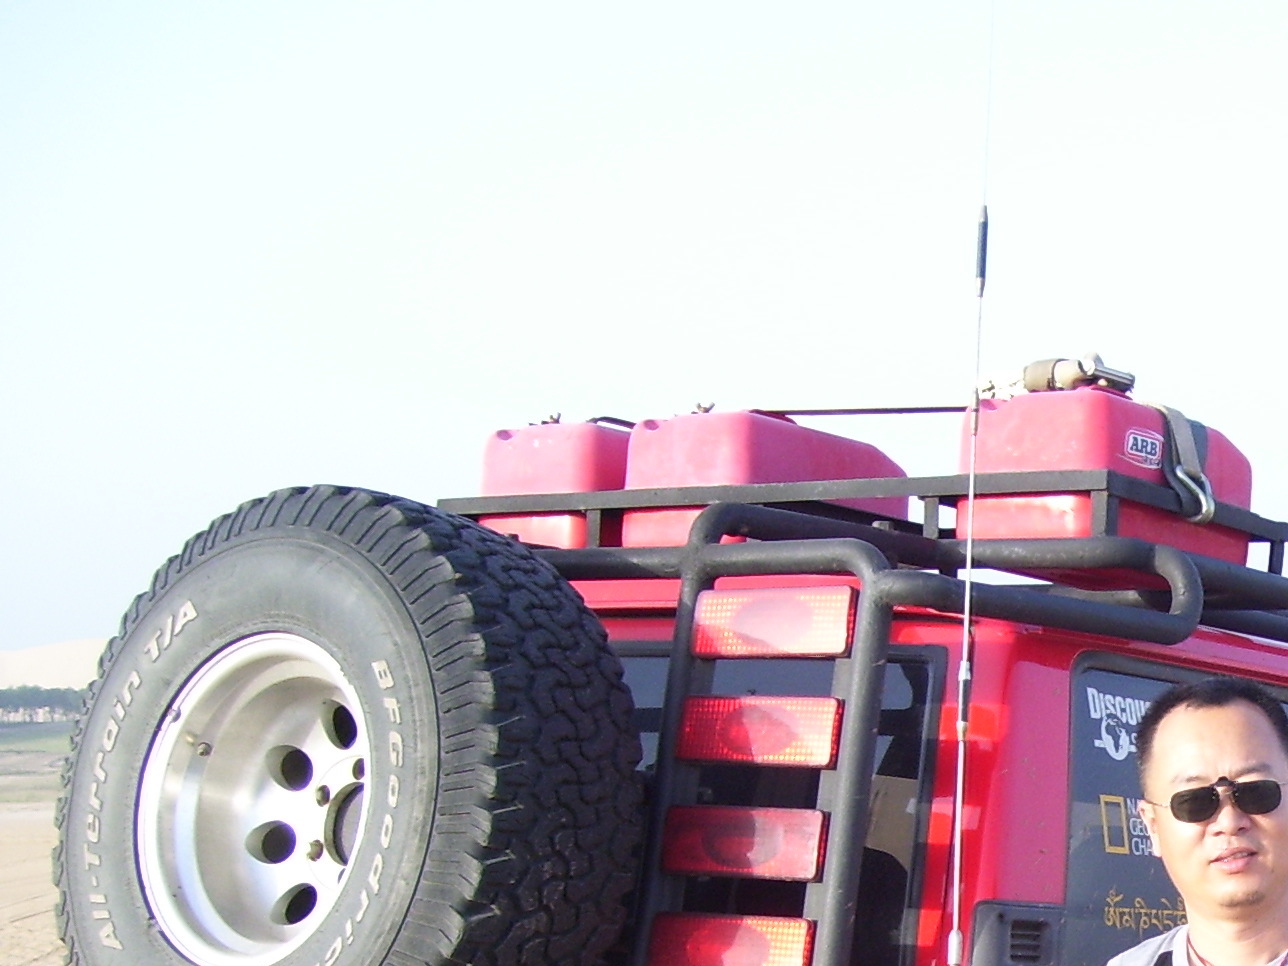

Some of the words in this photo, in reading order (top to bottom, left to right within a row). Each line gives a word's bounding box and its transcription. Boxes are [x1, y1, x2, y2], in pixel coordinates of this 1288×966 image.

[1129, 436, 1158, 457] ARB
[144, 599, 198, 663] T/A
[1129, 818, 1150, 836] GEO
[1131, 837, 1155, 856] CHA
